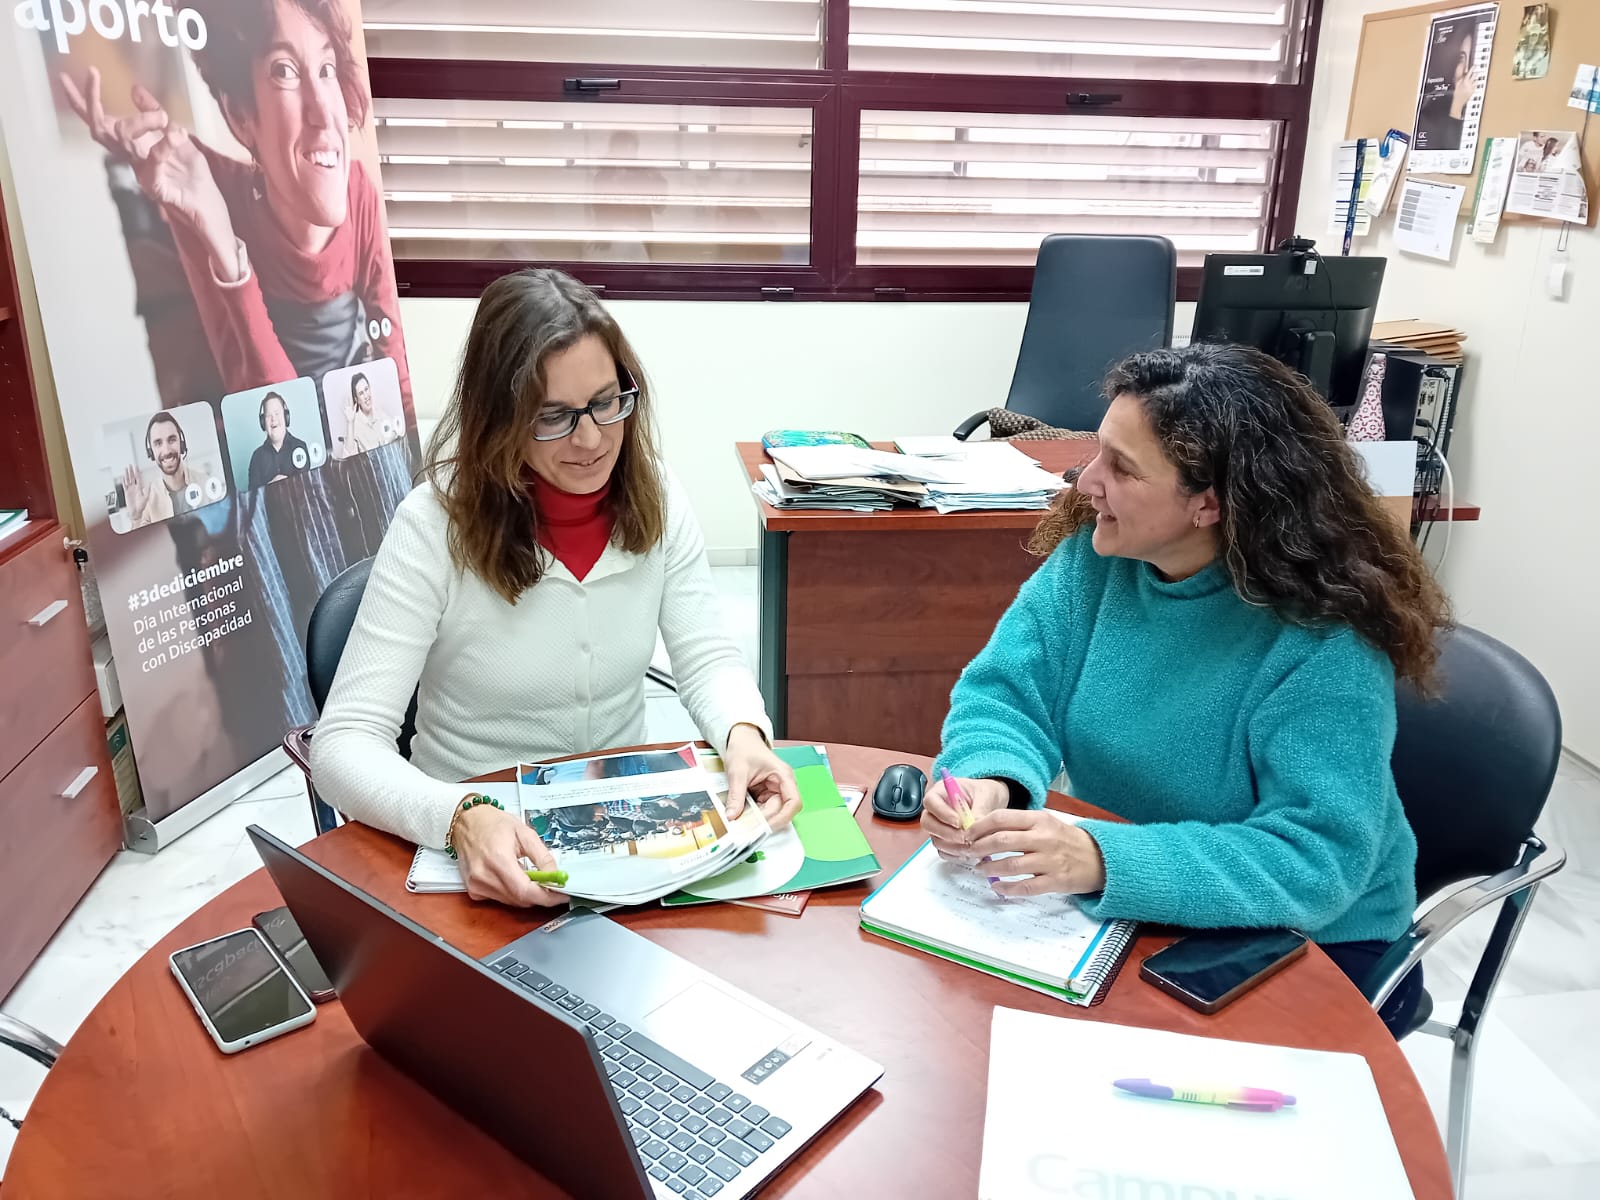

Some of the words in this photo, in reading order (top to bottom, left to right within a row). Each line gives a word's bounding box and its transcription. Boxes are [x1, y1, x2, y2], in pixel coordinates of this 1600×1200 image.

[14, 0, 207, 54] aporto
[128, 554, 244, 611] #3dediciembre
[133, 614, 157, 635] Día
[159, 576, 244, 624] Internacional
[138, 636, 156, 653] de
[157, 627, 177, 644] las
[179, 600, 236, 635] Personas
[142, 653, 167, 673] con
[168, 609, 253, 661] Discapacidad
